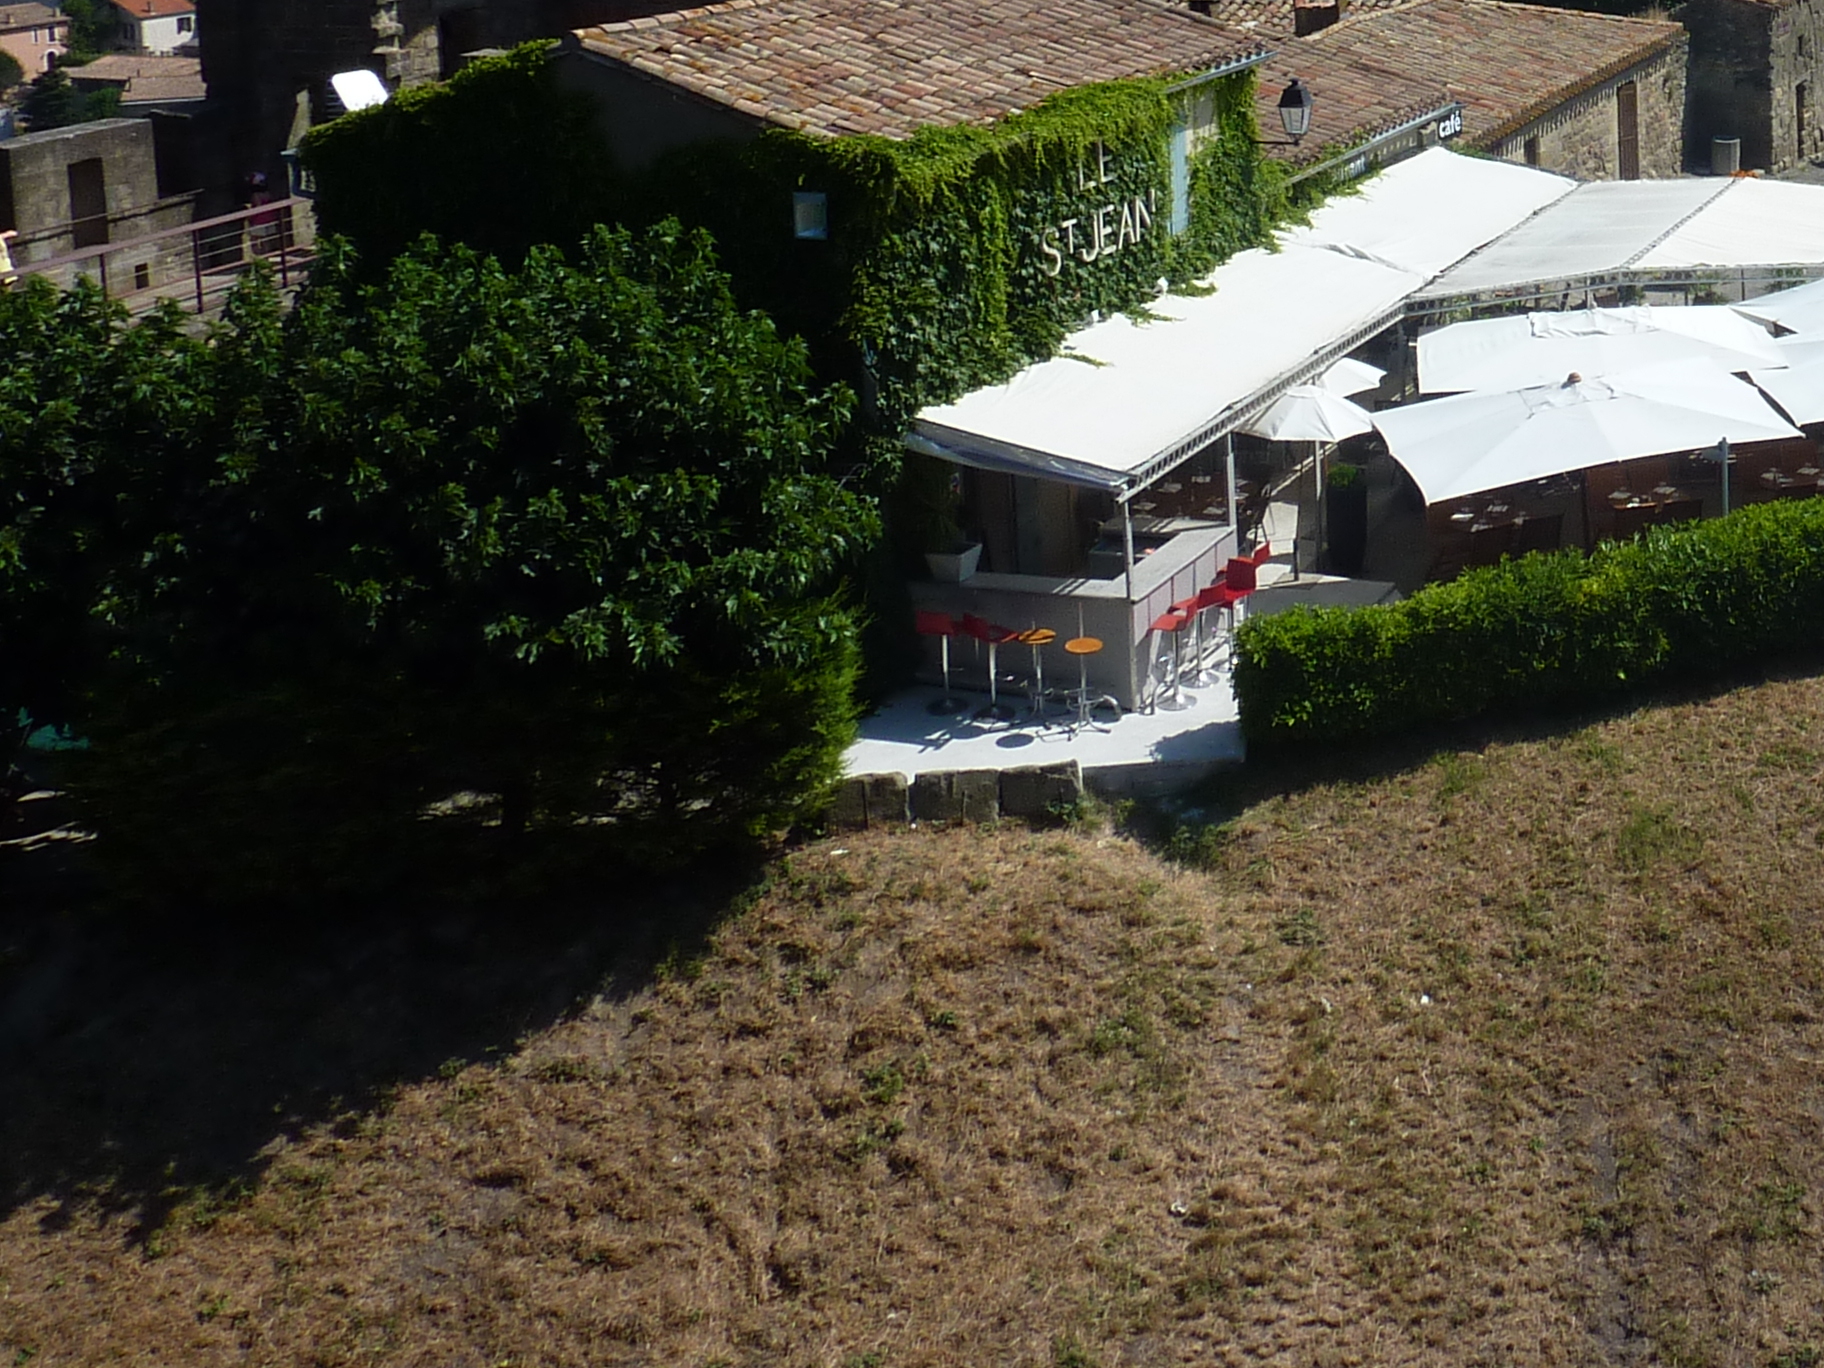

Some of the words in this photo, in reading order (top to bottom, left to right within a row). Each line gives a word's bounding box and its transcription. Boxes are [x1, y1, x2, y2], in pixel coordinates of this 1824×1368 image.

[1438, 110, 1462, 138] café
[1078, 139, 1117, 191] LE
[1043, 218, 1078, 277] ST
[1079, 188, 1156, 262] JEAN
